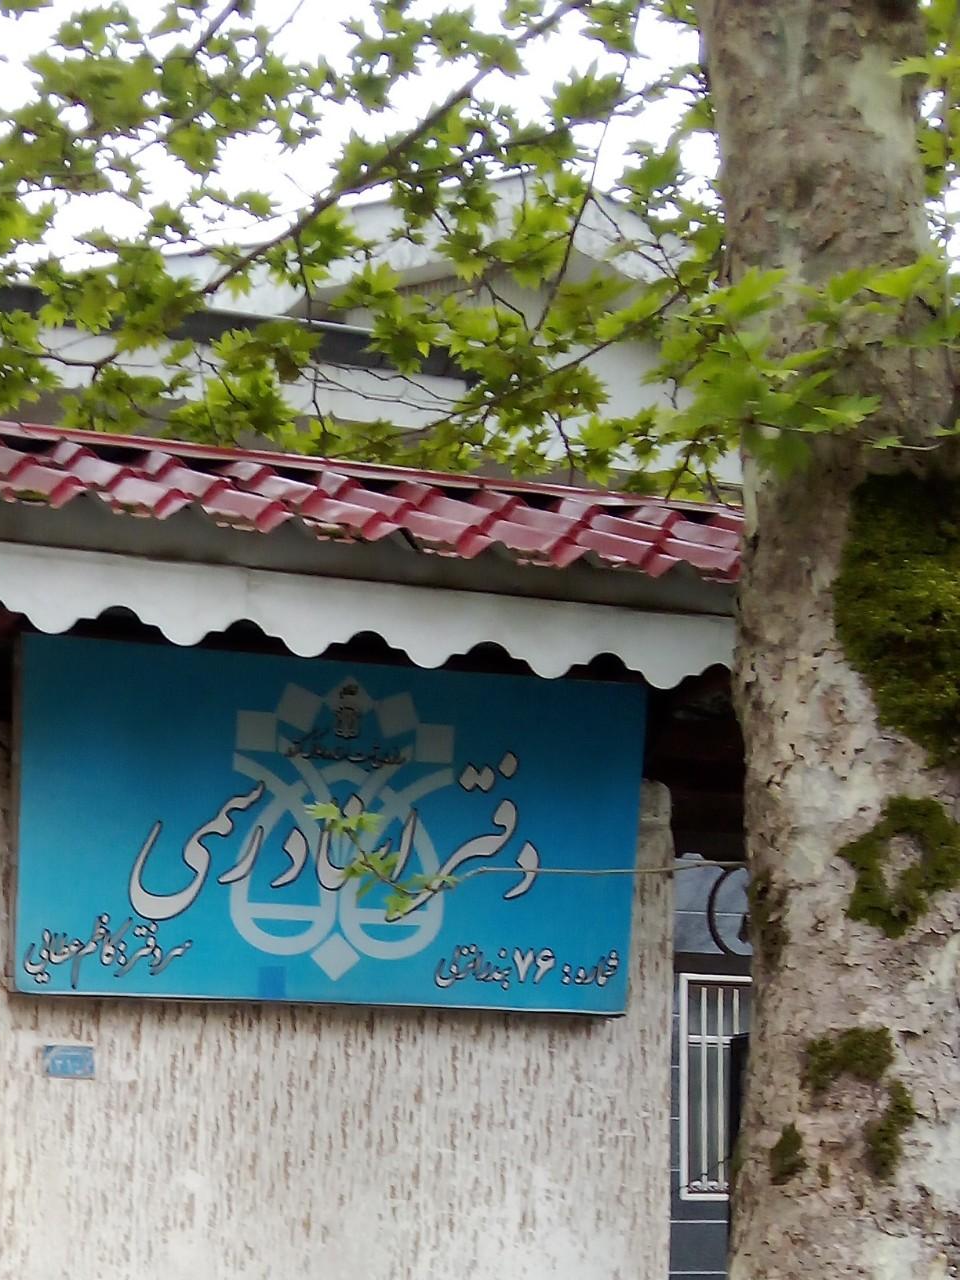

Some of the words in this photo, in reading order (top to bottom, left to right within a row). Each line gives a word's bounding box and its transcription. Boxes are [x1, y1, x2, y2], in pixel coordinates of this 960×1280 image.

[128, 779, 266, 922] رسمی
[385, 751, 540, 923] دفتر
[513, 947, 556, 985] ۷۶
